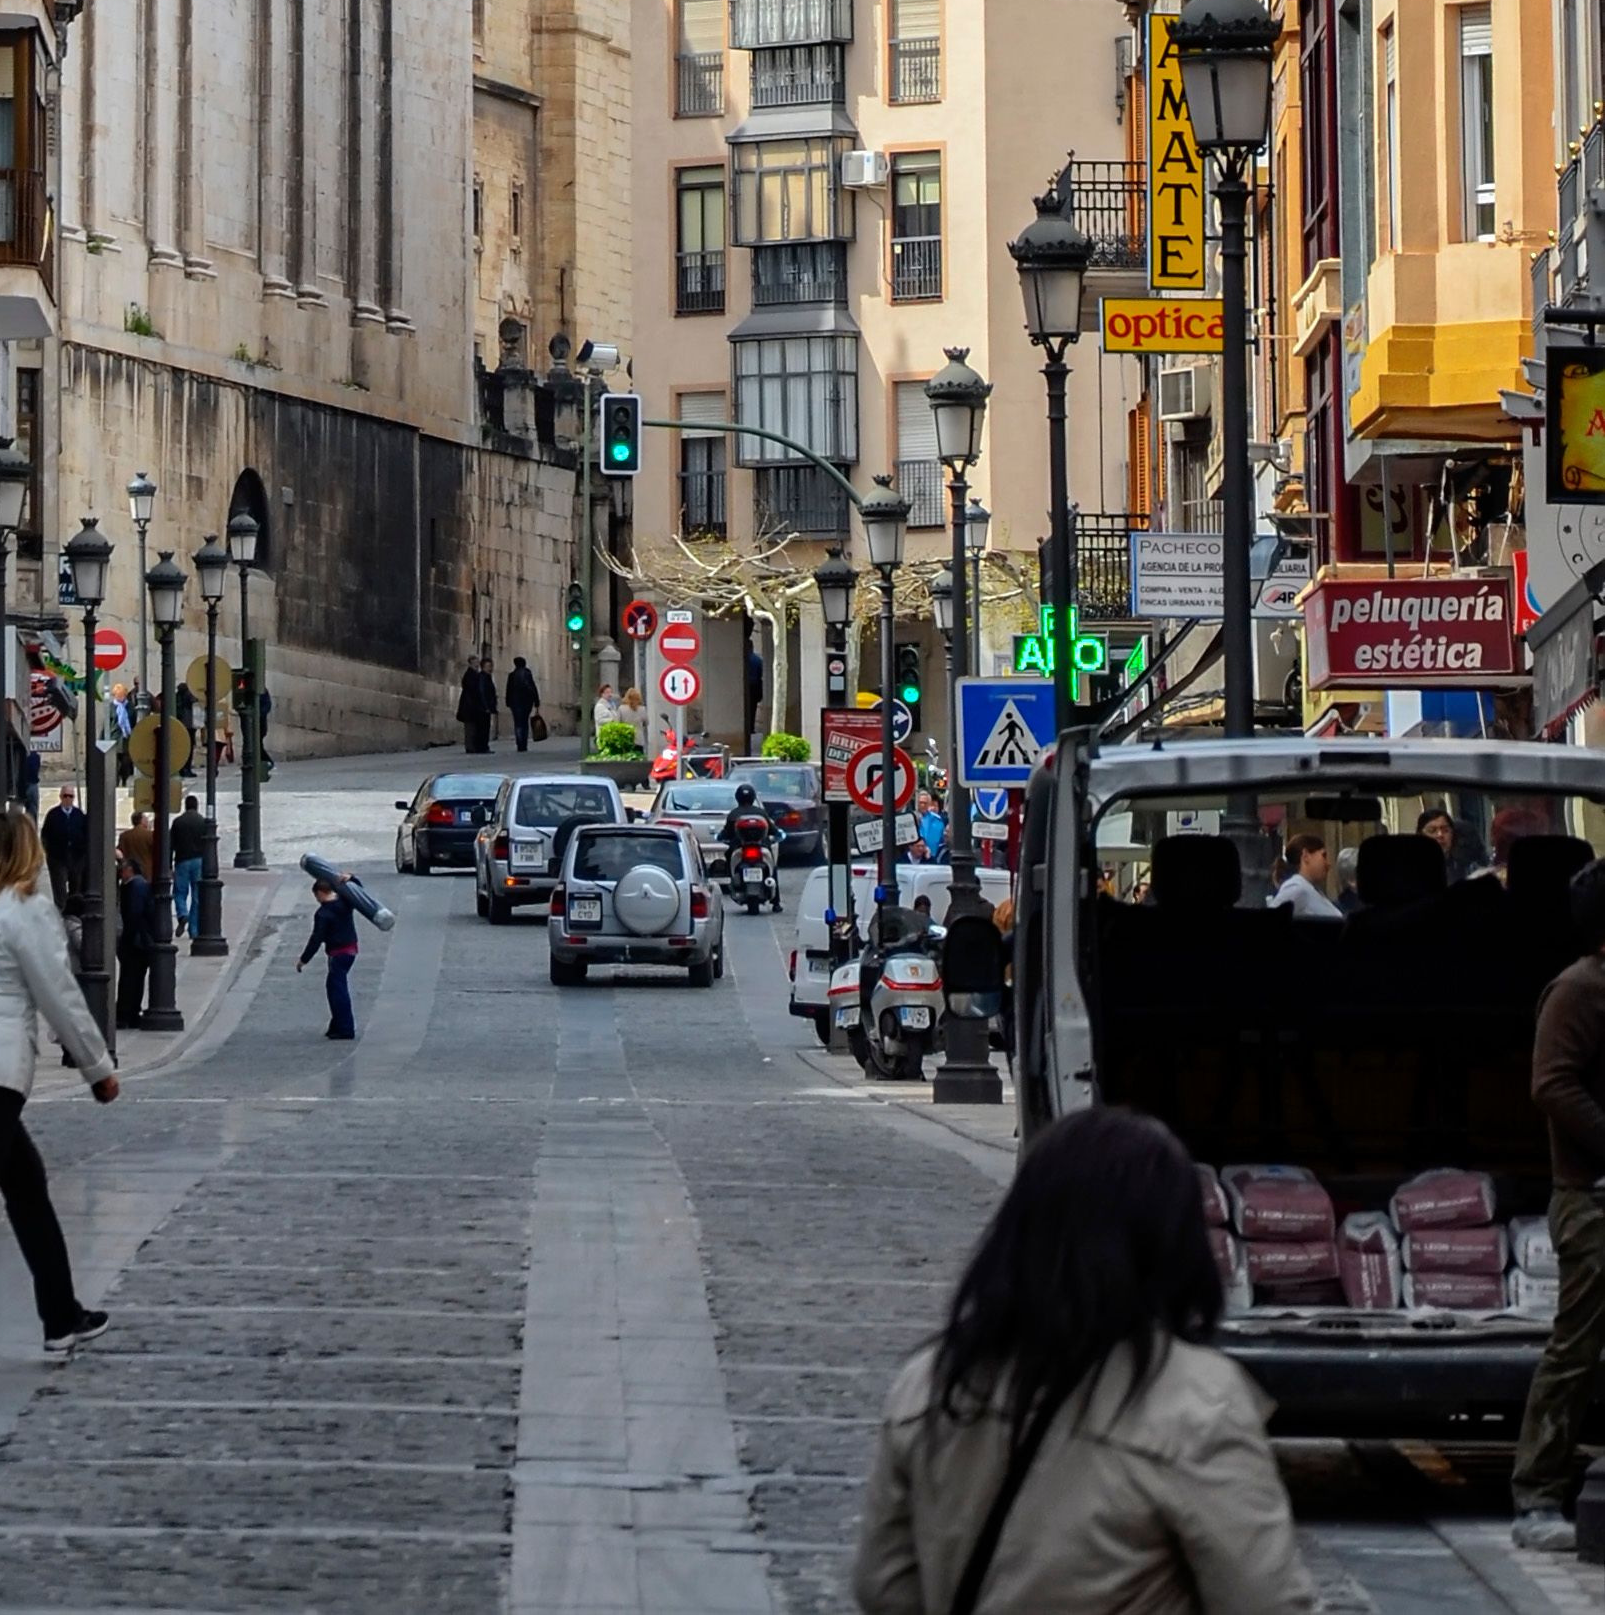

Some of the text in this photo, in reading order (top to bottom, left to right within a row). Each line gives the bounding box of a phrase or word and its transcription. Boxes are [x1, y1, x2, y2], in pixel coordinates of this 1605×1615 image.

[1107, 306, 1224, 347] optica
[1140, 540, 1222, 555] PACHECO
[1140, 562, 1177, 572] AGENCIA
[1178, 562, 1190, 572] DE
[1191, 563, 1202, 572] LA
[1139, 586, 1172, 594] COMPRA
[1330, 585, 1504, 633] peluquería
[1354, 633, 1484, 671] estética
